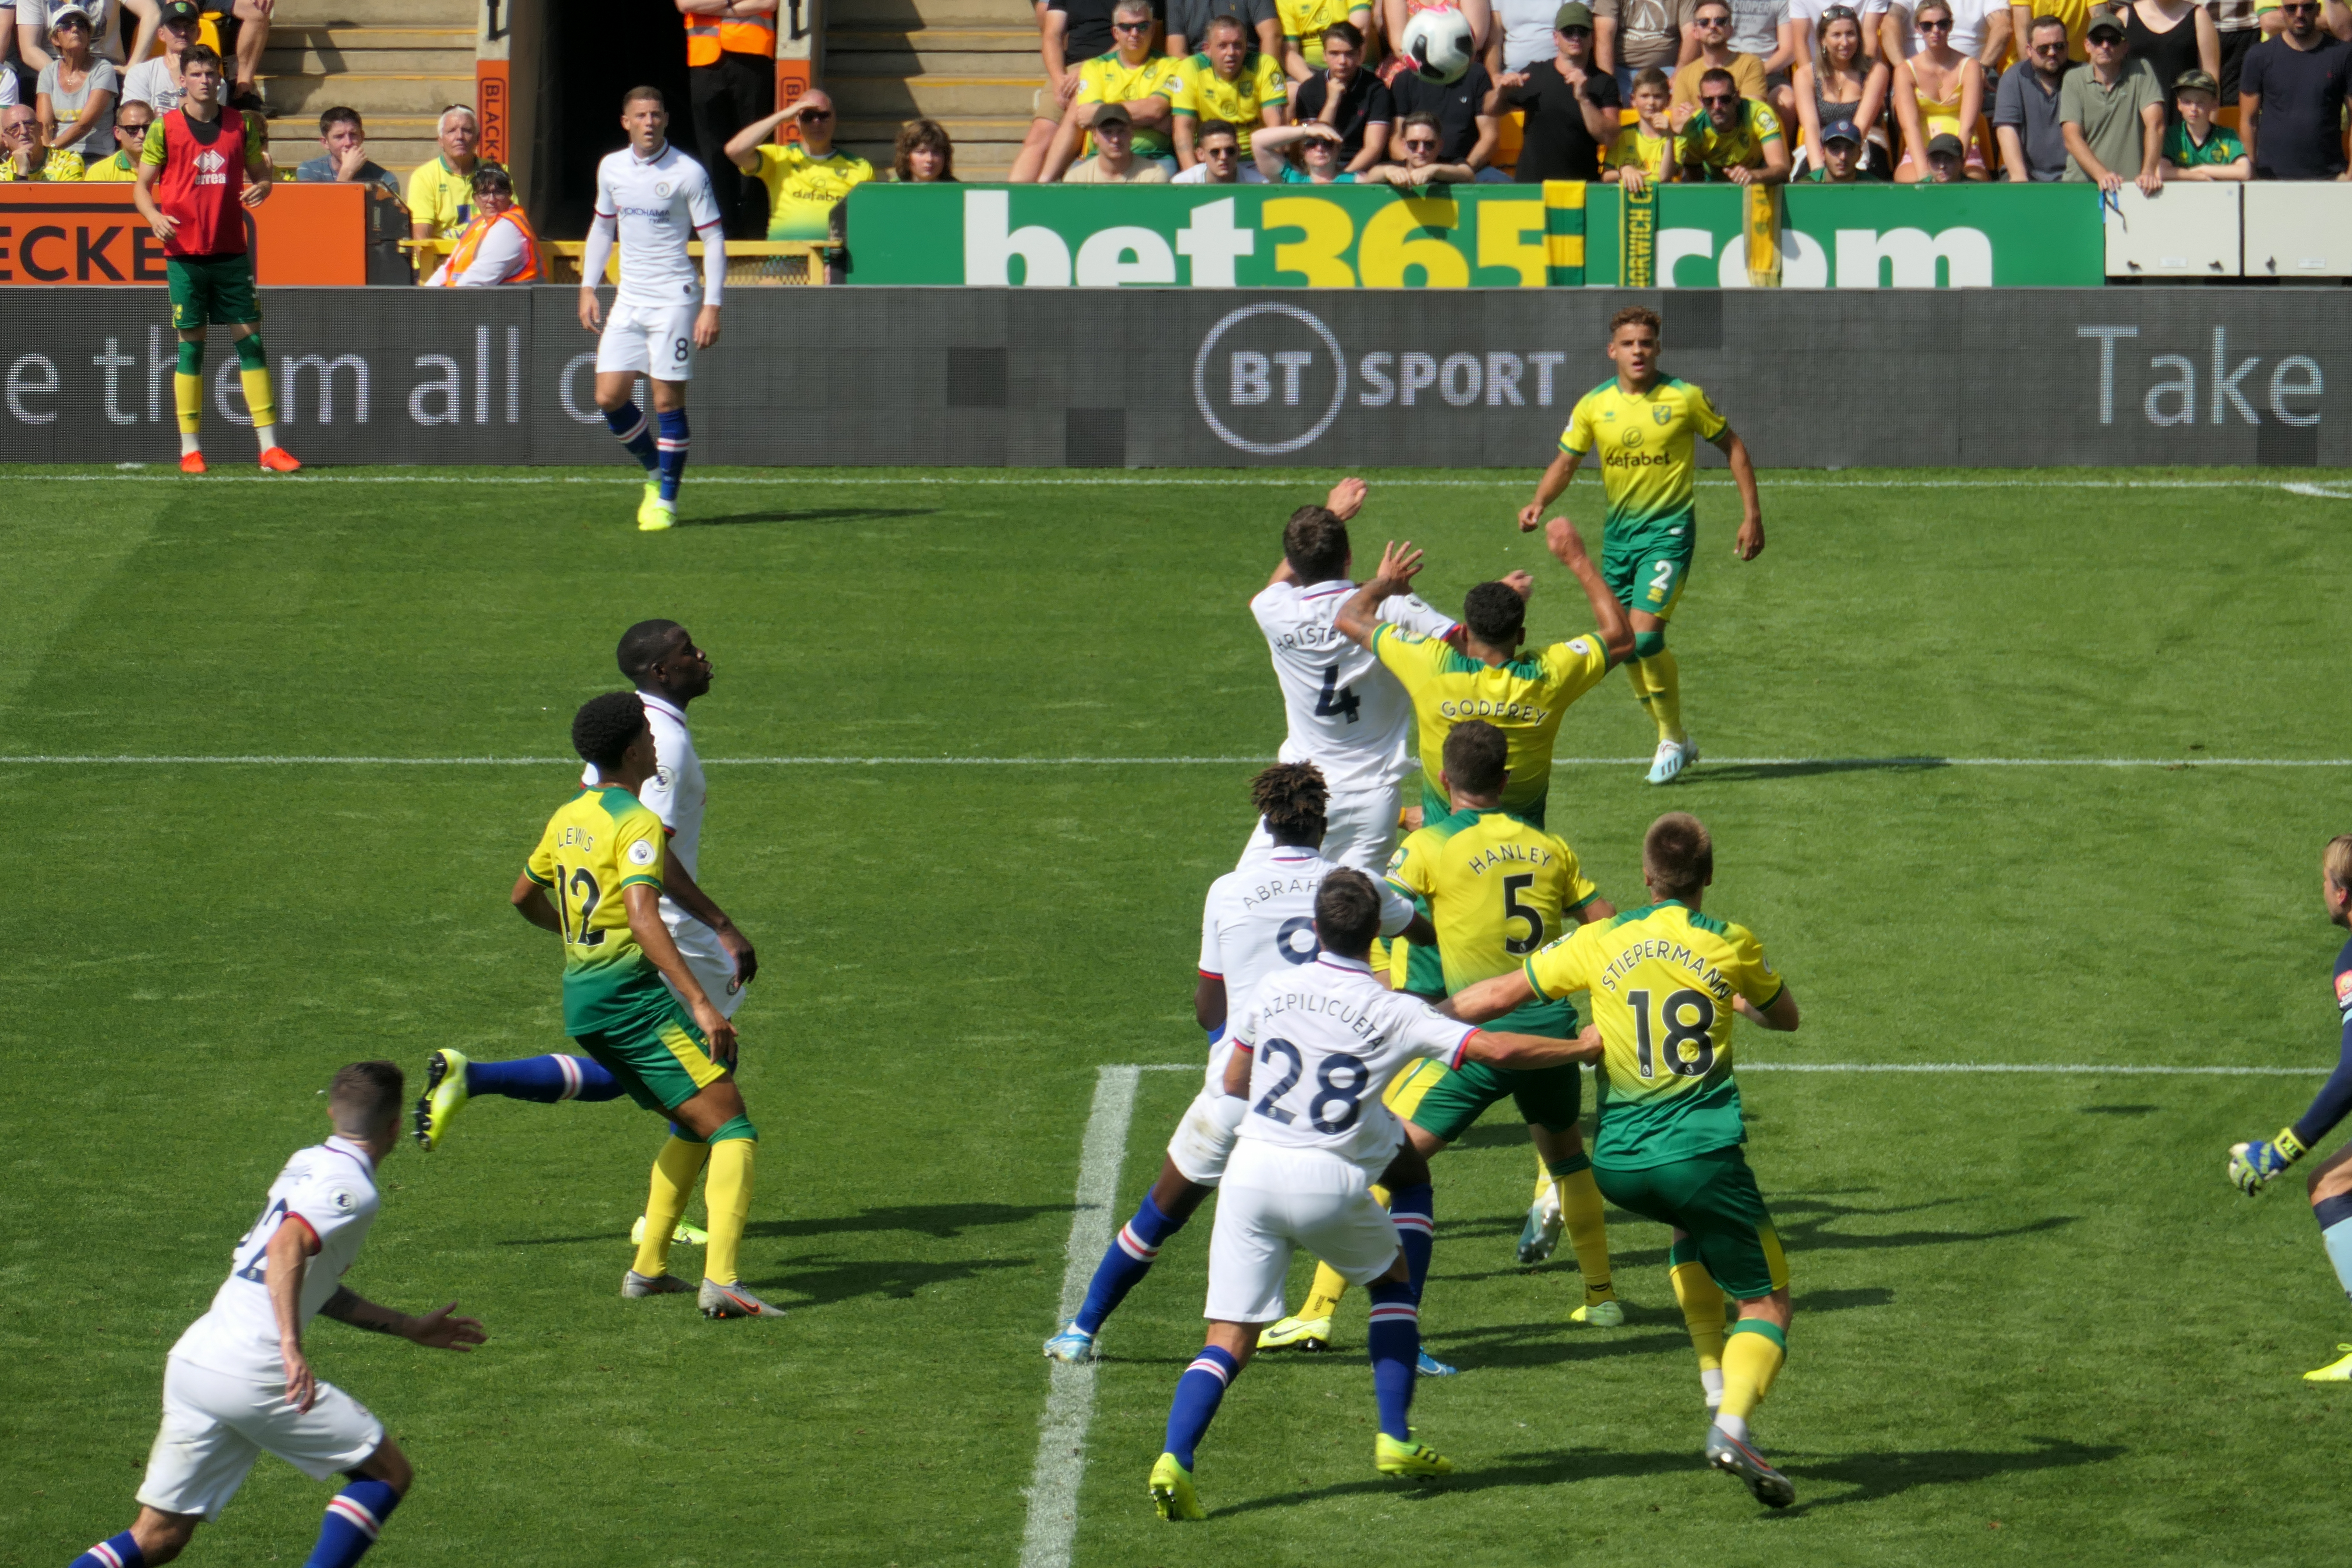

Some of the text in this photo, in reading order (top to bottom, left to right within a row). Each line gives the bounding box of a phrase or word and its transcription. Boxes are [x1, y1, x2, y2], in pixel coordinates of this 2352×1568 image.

[793, 189, 842, 201] dafabe
[93, 324, 370, 425] them
[408, 325, 519, 425] all
[674, 338, 688, 362] 8
[2076, 324, 2324, 426] Take
[1230, 351, 1566, 406] BT SPORT
[1606, 451, 1671, 469] dafabet
[1650, 560, 1673, 590] 2
[1273, 627, 1338, 657] HRISTE
[1315, 665, 1361, 724] 4
[1441, 700, 1549, 726] GODFREY
[558, 827, 594, 852] LEWIS
[1468, 844, 1552, 876] HANLEY
[555, 863, 606, 947] 12
[1243, 879, 1319, 911] ABRAH
[1503, 872, 1545, 955] 5
[1601, 939, 1732, 1002] STIEPERMANN
[1263, 993, 1386, 1051] AZPILICUETA
[1626, 988, 1715, 1078] 18
[1254, 1037, 1370, 1135] 28
